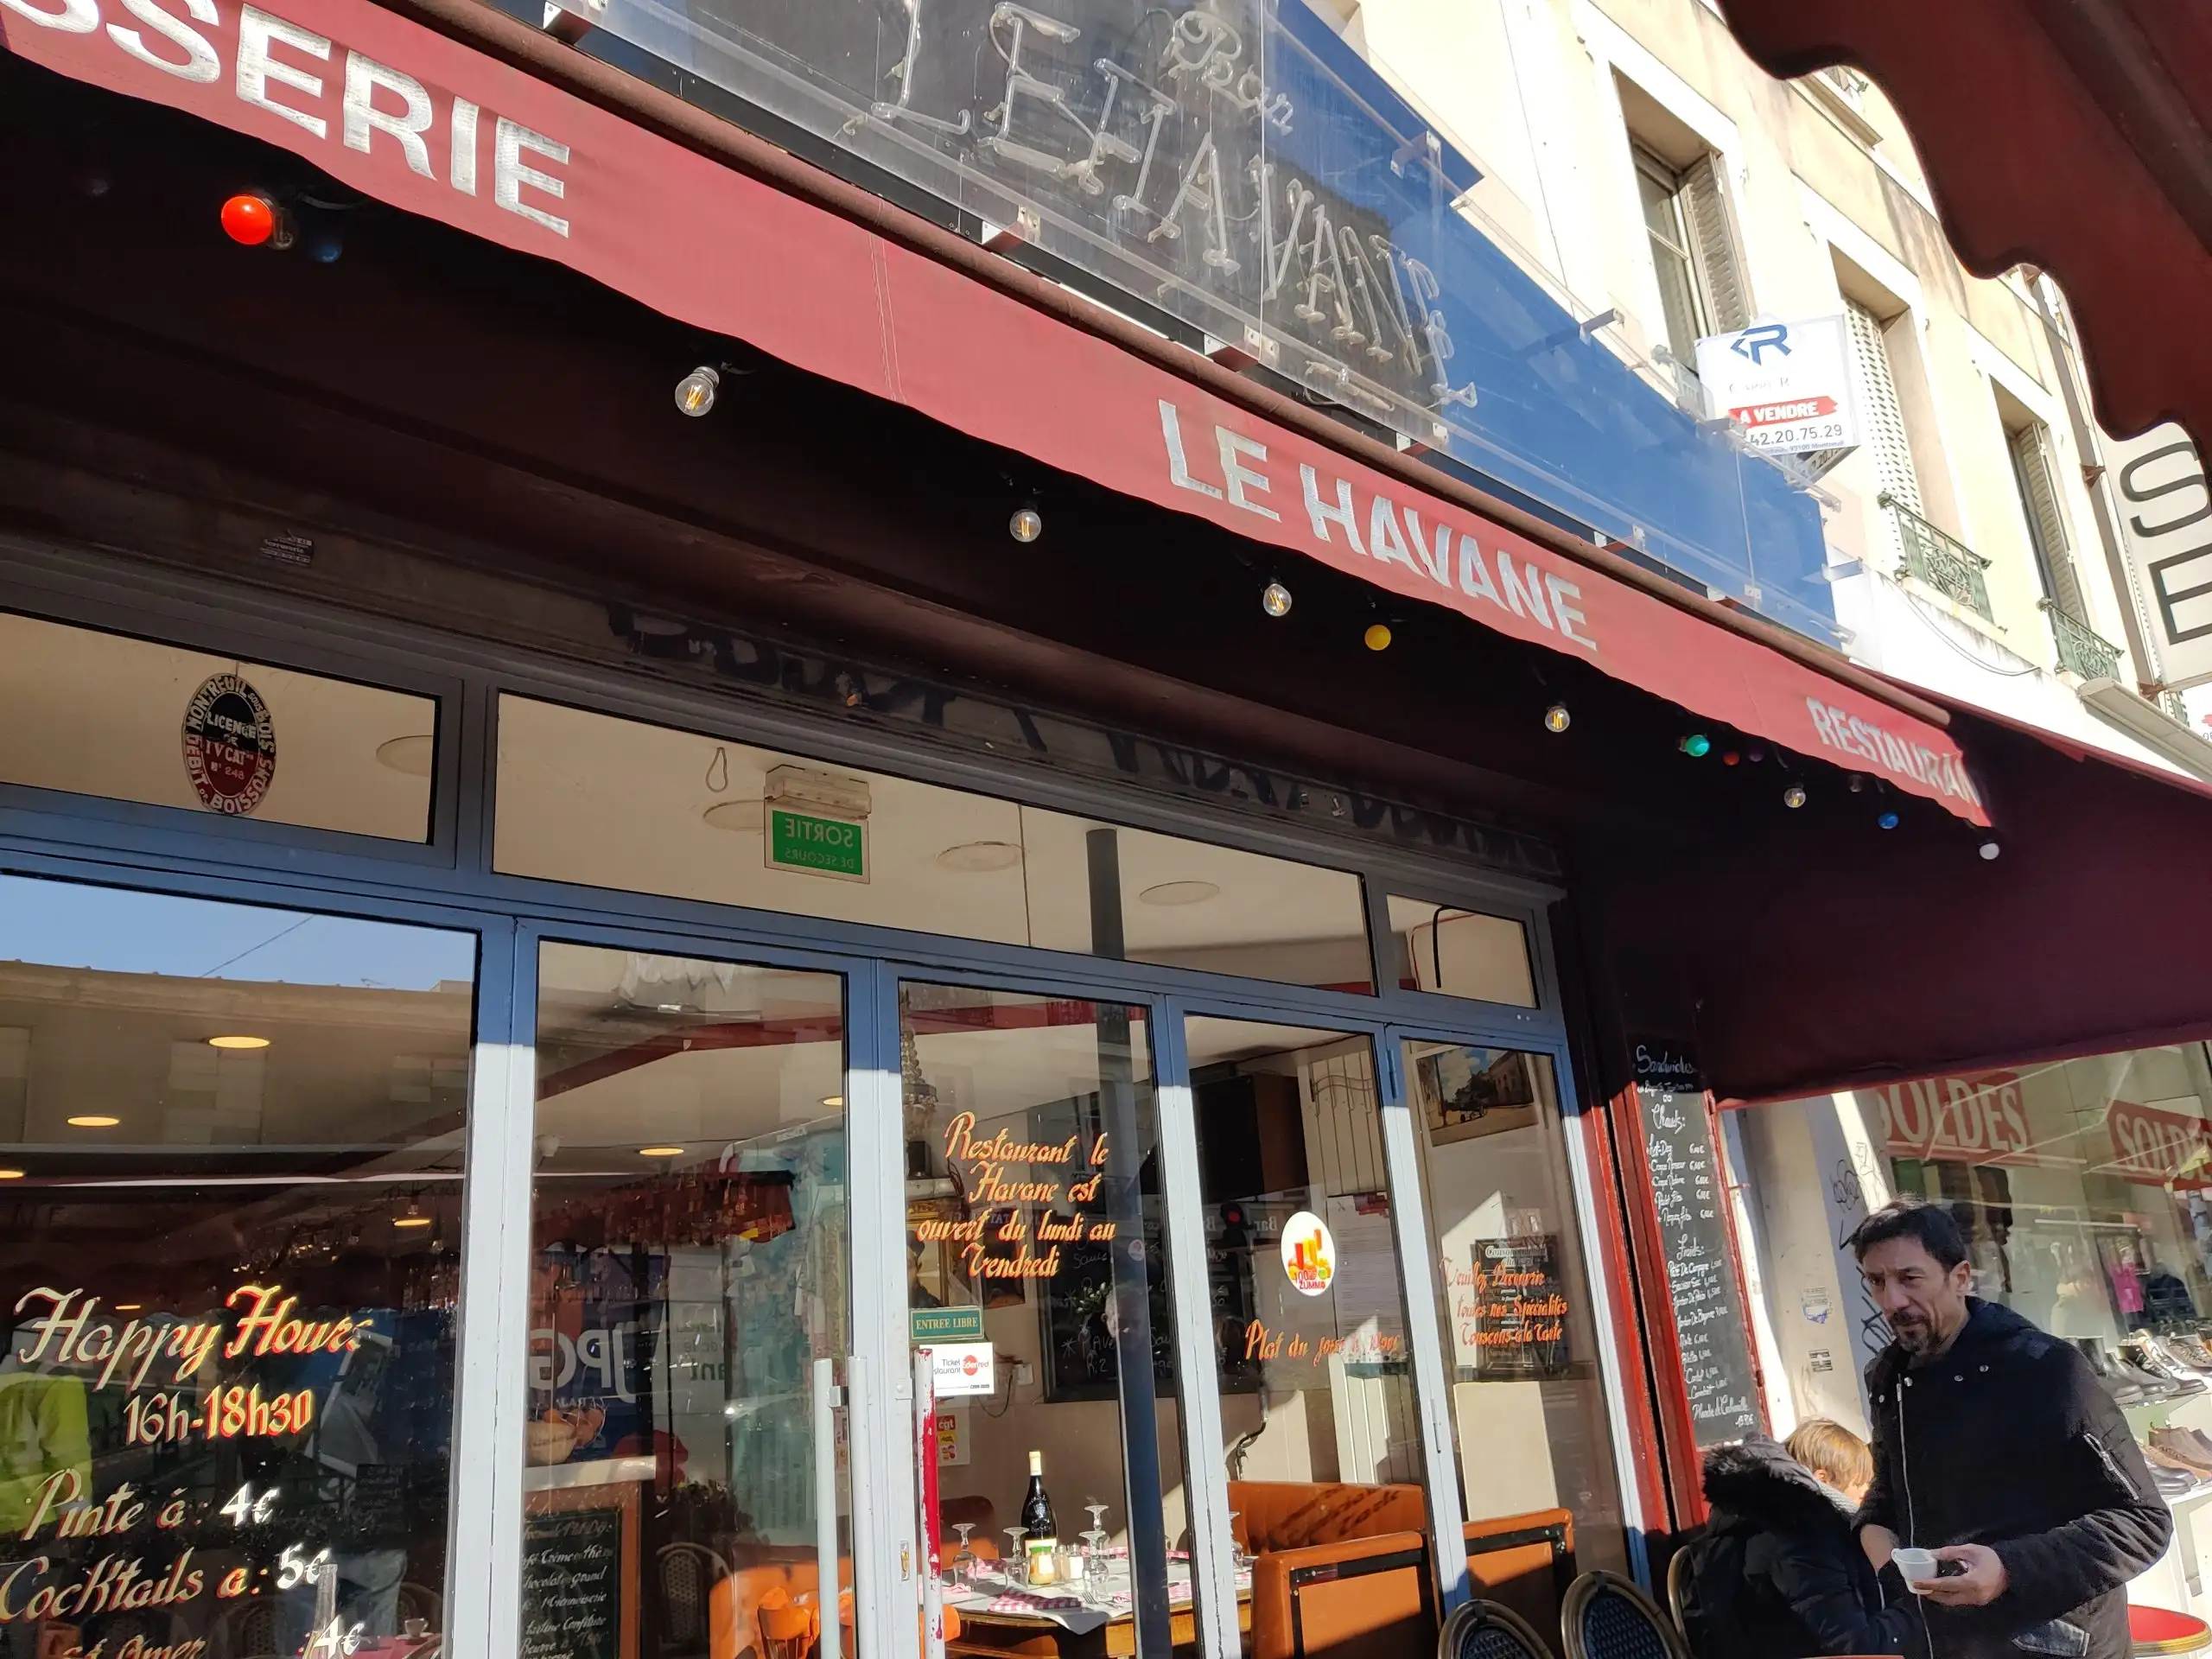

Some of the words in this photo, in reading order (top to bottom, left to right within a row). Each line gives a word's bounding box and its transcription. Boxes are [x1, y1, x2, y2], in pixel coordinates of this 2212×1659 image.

[1753, 401, 1819, 422] VENDRE
[1158, 398, 1281, 523] LE
[1300, 463, 1598, 652] HAVANE
[186, 676, 248, 730] MONTREUIL
[206, 710, 258, 740] LICENCE
[187, 734, 209, 785] DEBIT
[210, 758, 274, 813] BOISSONS
[944, 1111, 1077, 1163] Restaurant
[1089, 1131, 1109, 1166] le
[968, 1160, 1059, 1204] Havane
[1067, 1173, 1103, 1204] est
[915, 1207, 993, 1242] ouvert
[998, 1209, 1027, 1242] du
[1037, 1209, 1085, 1242] lundi
[1088, 1219, 1117, 1242] au
[961, 1242, 1061, 1279] Vendredi
[13, 1286, 223, 1394] Happy
[915, 1317, 950, 1330] ENTREE
[952, 1317, 978, 1328] LIBRE
[1245, 1319, 1284, 1360] Plat
[1287, 1332, 1309, 1357] du
[933, 1366, 961, 1375] staurant
[124, 1382, 315, 1446] 16h-18h30
[21, 1468, 145, 1541] Pinte
[219, 1481, 281, 1528] 4€
[276, 1541, 333, 1590] 5€
